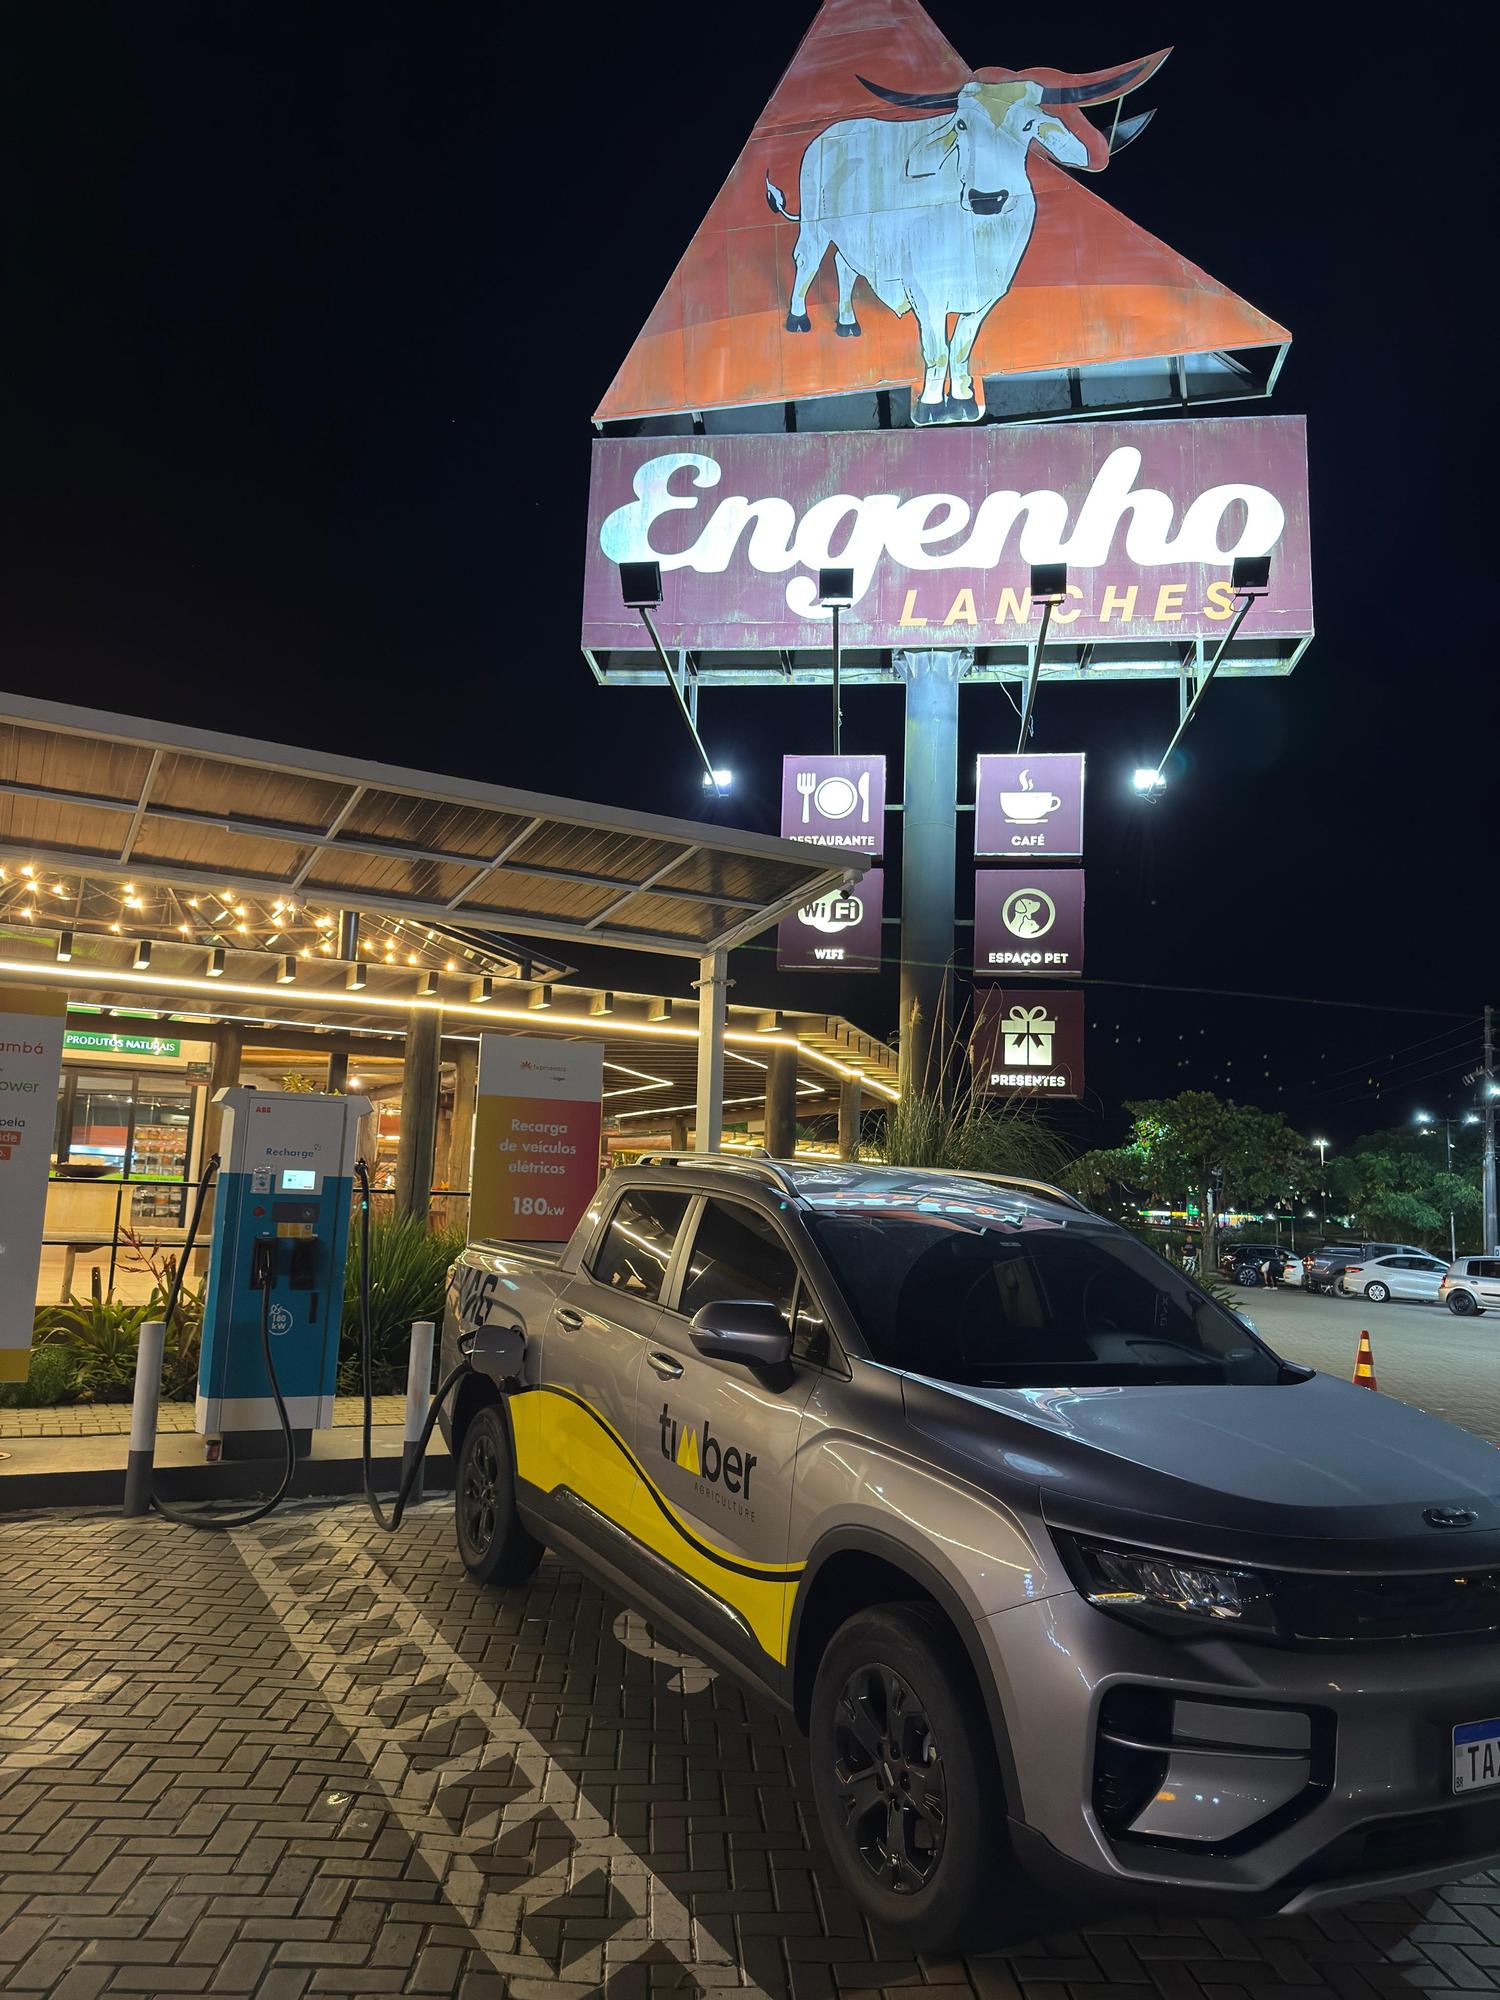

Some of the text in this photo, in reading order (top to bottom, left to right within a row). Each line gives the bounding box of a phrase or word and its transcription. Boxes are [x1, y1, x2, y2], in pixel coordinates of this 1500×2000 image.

[600, 446, 1285, 619] Engenho
[899, 582, 1234, 626] LANCHES
[1011, 835, 1045, 846] CAFÉ
[814, 949, 844, 960] WIFI
[988, 952, 1068, 966] ESPAÇO PET
[66, 1035, 176, 1052] PRODUTOS NATURAIS
[991, 1074, 1066, 1087] PRESENTES
[511, 1119, 568, 1136] Recarga
[266, 1147, 314, 1159] Recharge
[499, 1138, 577, 1155] de veículos
[508, 1160, 566, 1174] elétricos
[693, 1481, 756, 1523] AGRICULTURE
